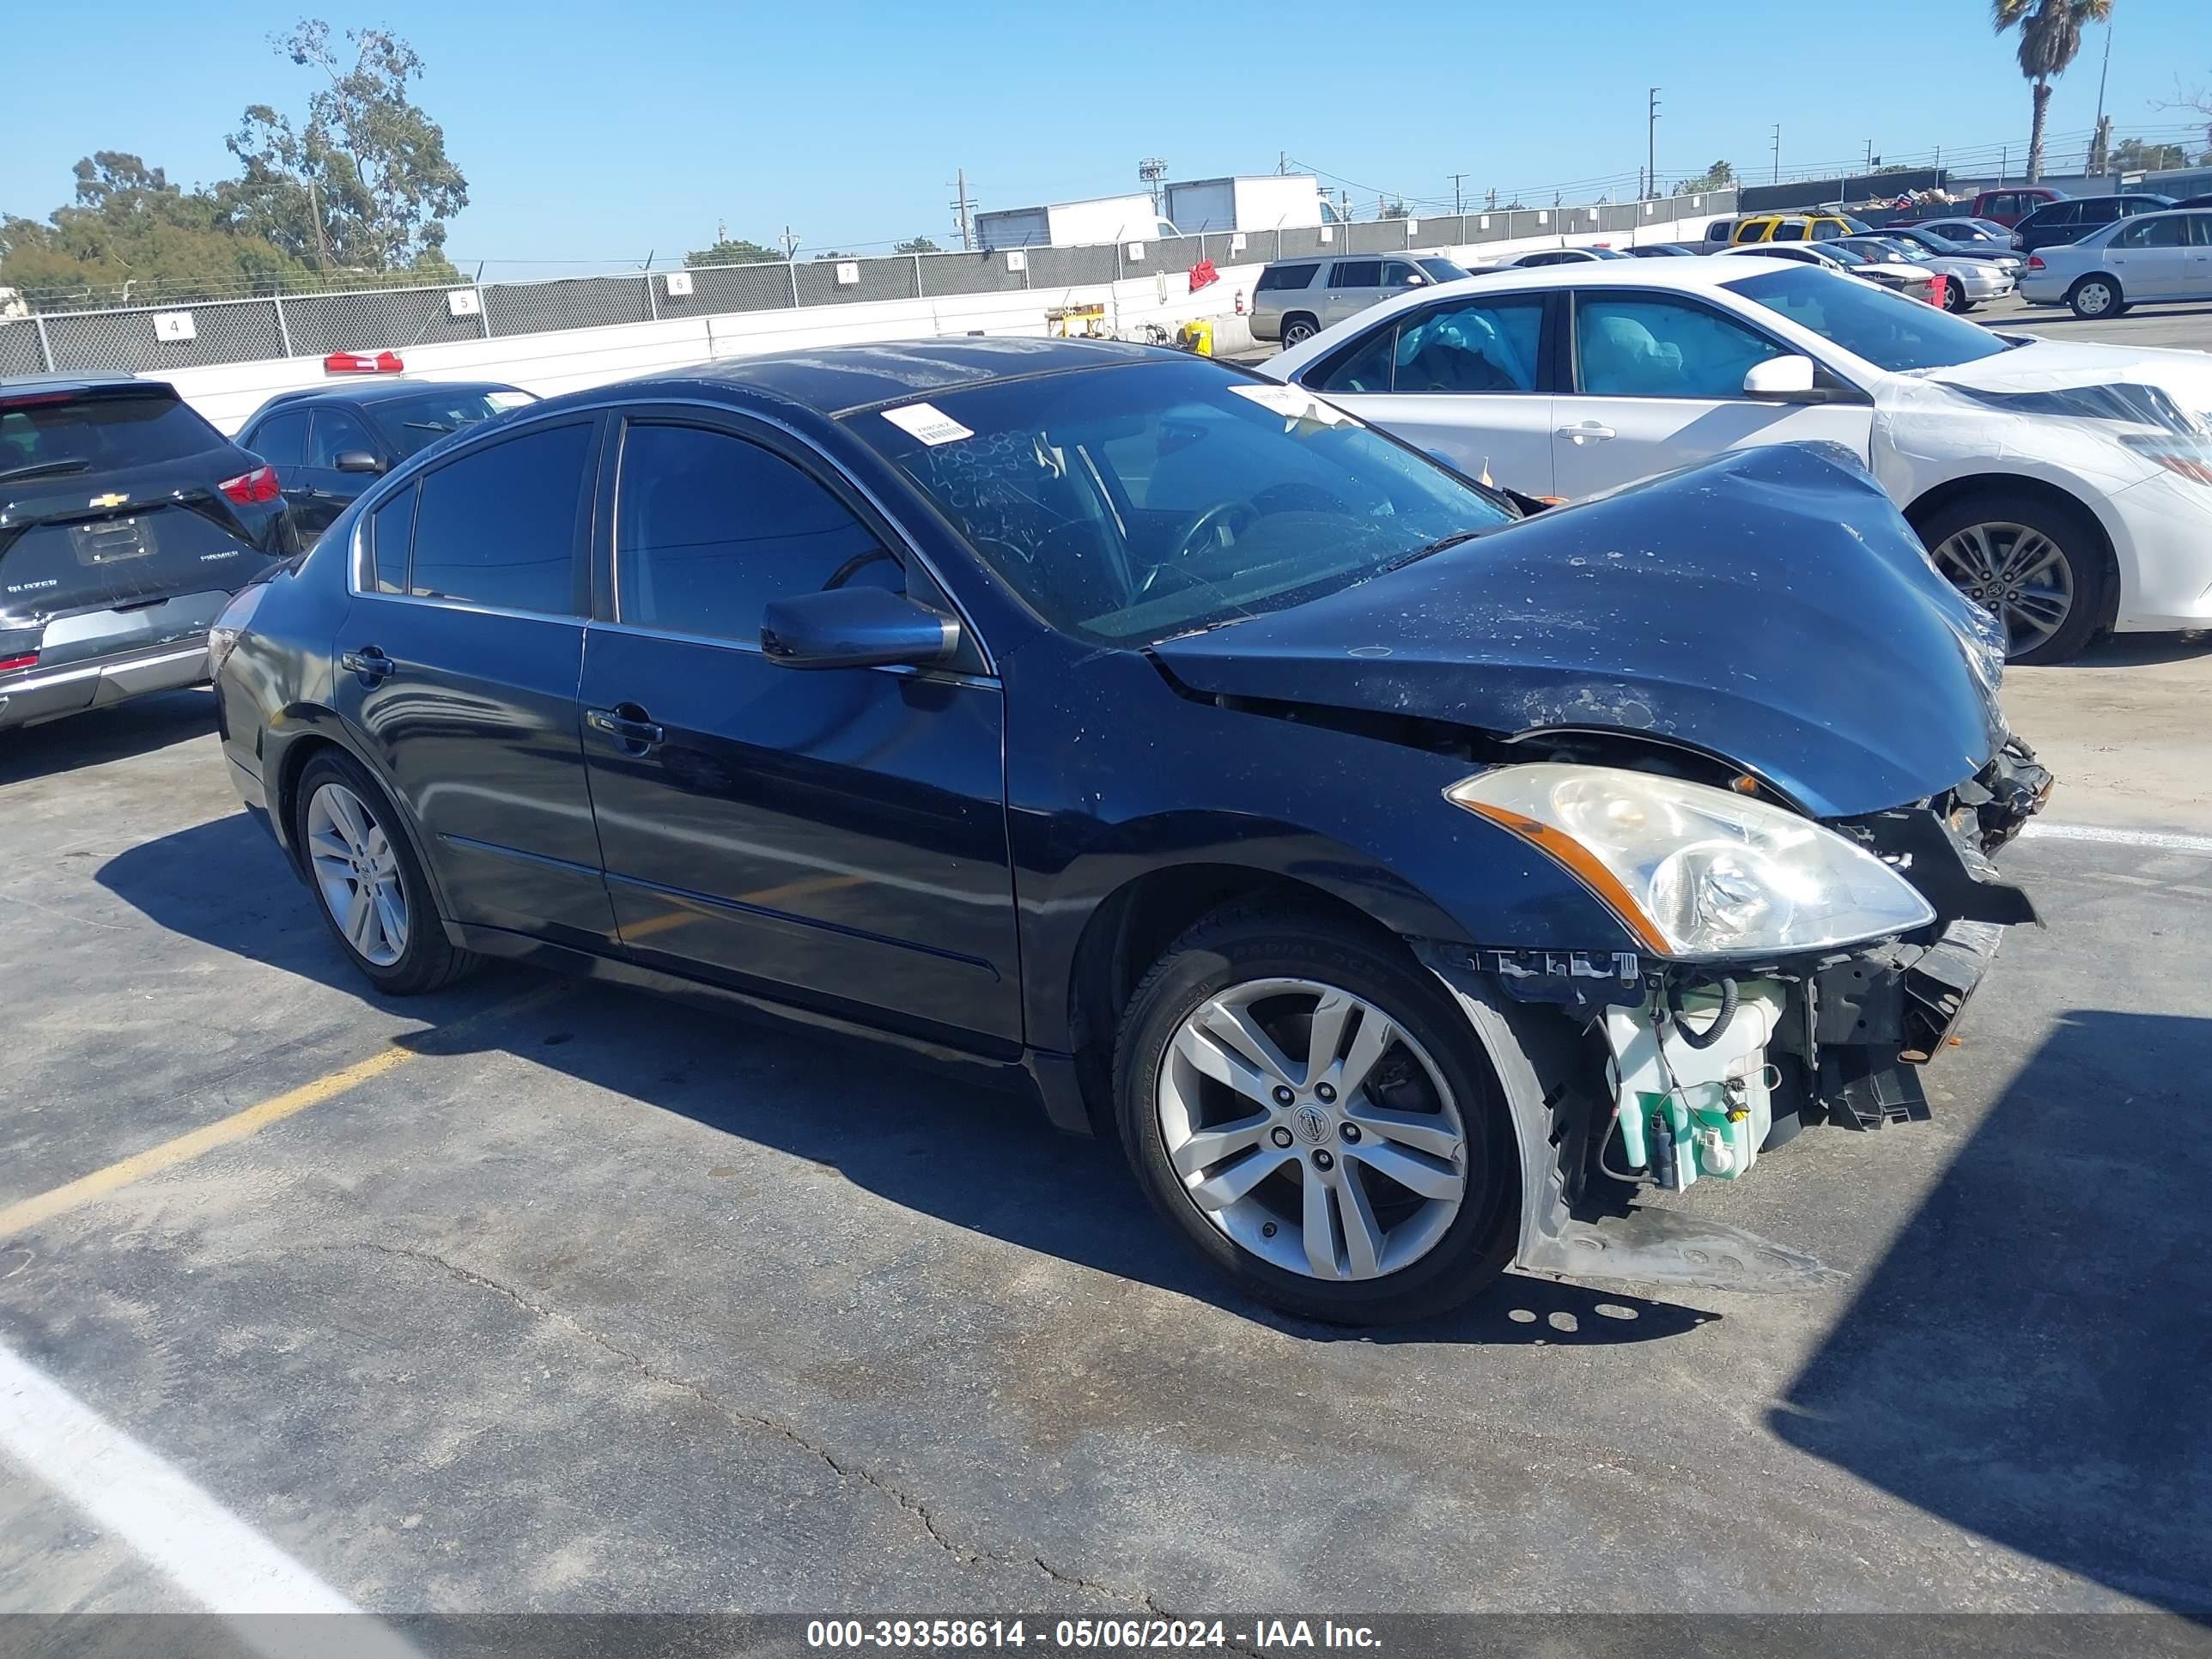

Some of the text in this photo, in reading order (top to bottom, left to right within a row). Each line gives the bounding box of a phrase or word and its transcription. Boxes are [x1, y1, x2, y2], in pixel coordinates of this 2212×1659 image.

[845, 268, 850, 278] 7
[677, 278, 684, 289] 6
[460, 296, 468, 308] 5
[170, 320, 179, 333] 4
[200, 550, 239, 562] PREMIER
[7, 580, 58, 592] BLAZER
